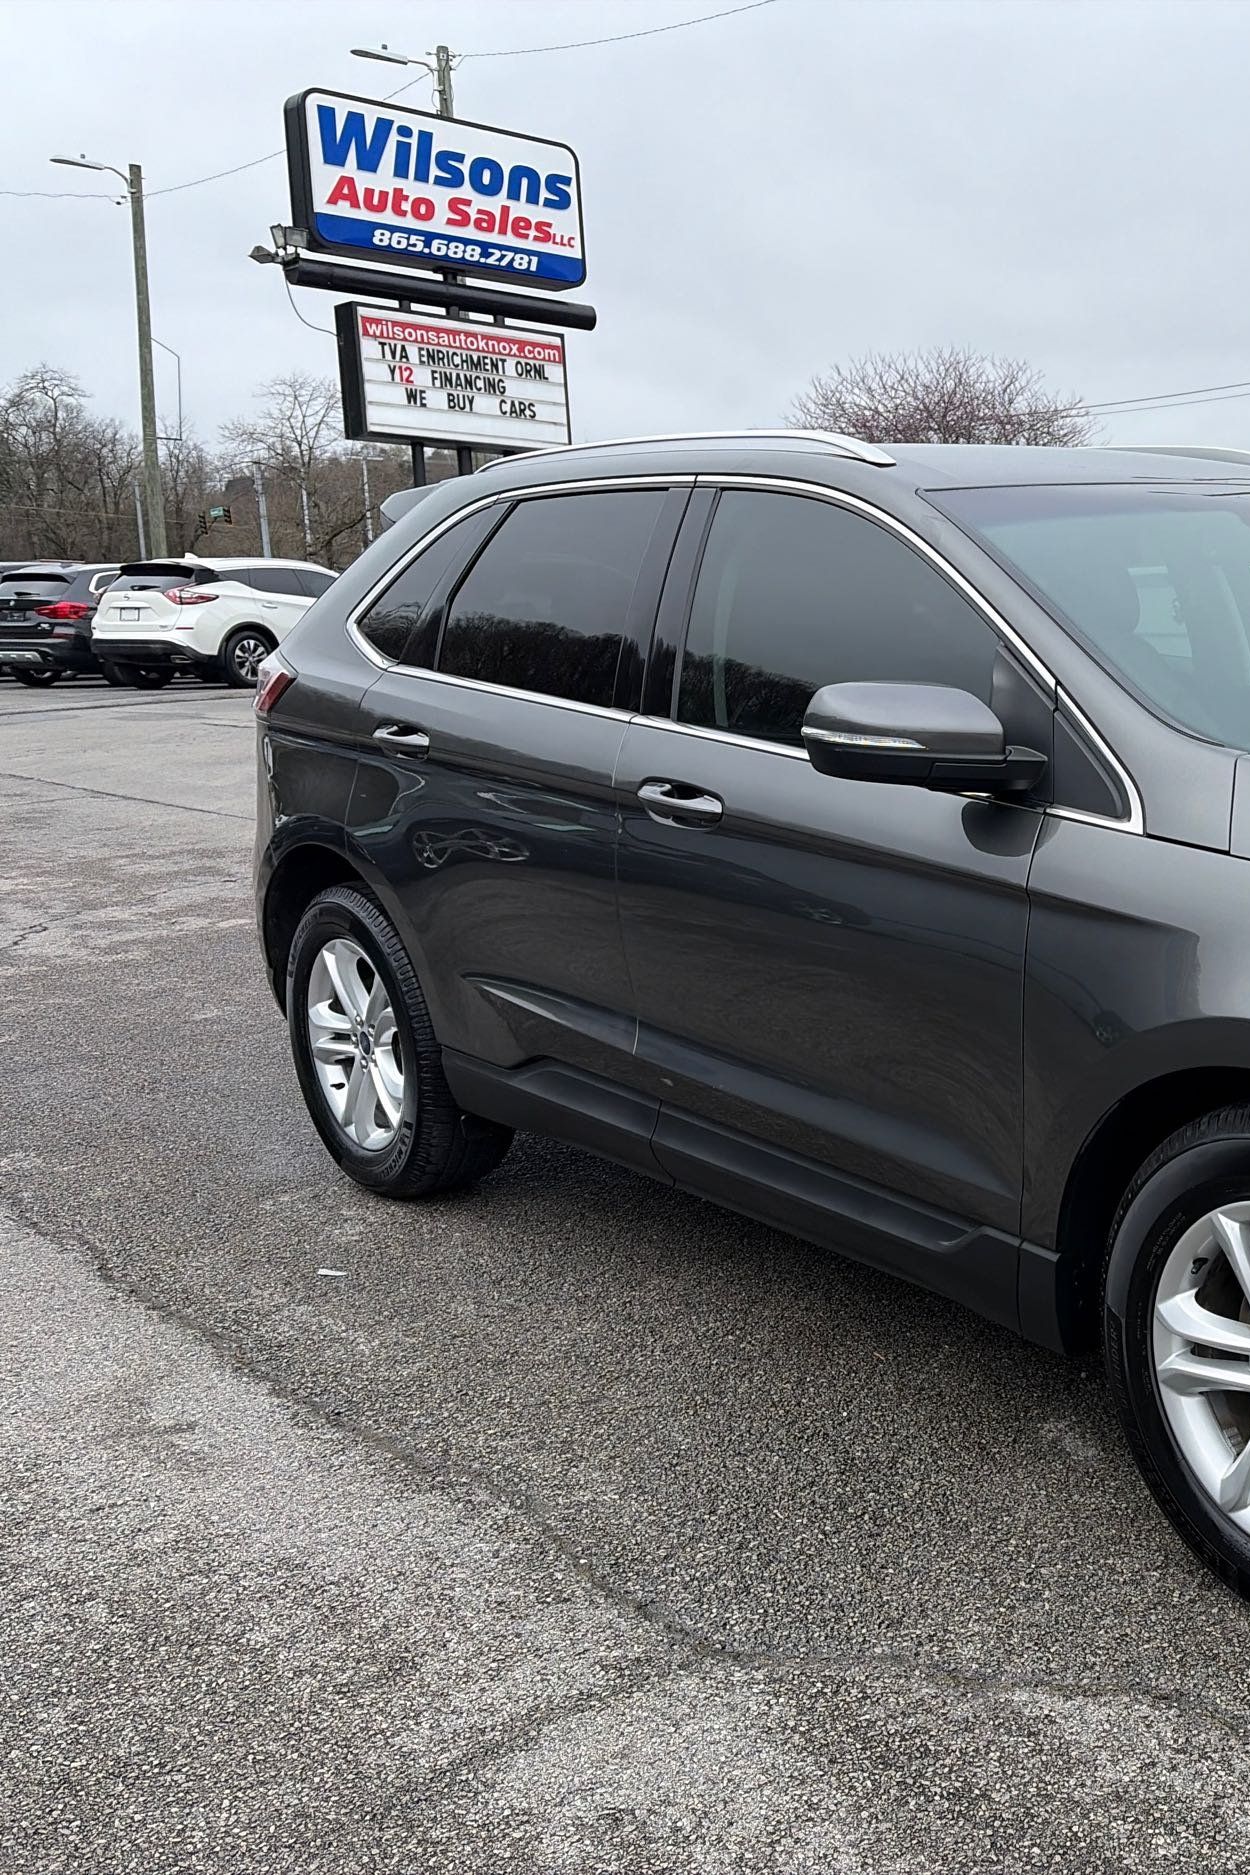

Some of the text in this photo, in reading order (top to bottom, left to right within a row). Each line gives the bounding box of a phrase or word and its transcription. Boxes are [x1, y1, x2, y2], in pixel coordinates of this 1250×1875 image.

[316, 104, 573, 211] Wilsons
[326, 175, 575, 248] Auto Sales LLC
[372, 229, 539, 272] 865.688.2781
[365, 320, 560, 362] wilsonsautoknox.com
[377, 341, 549, 381] TVA ENRICHMENT ORNL
[388, 364, 507, 395] Y12 FINANCING
[405, 387, 537, 419] WE BUY CARS
